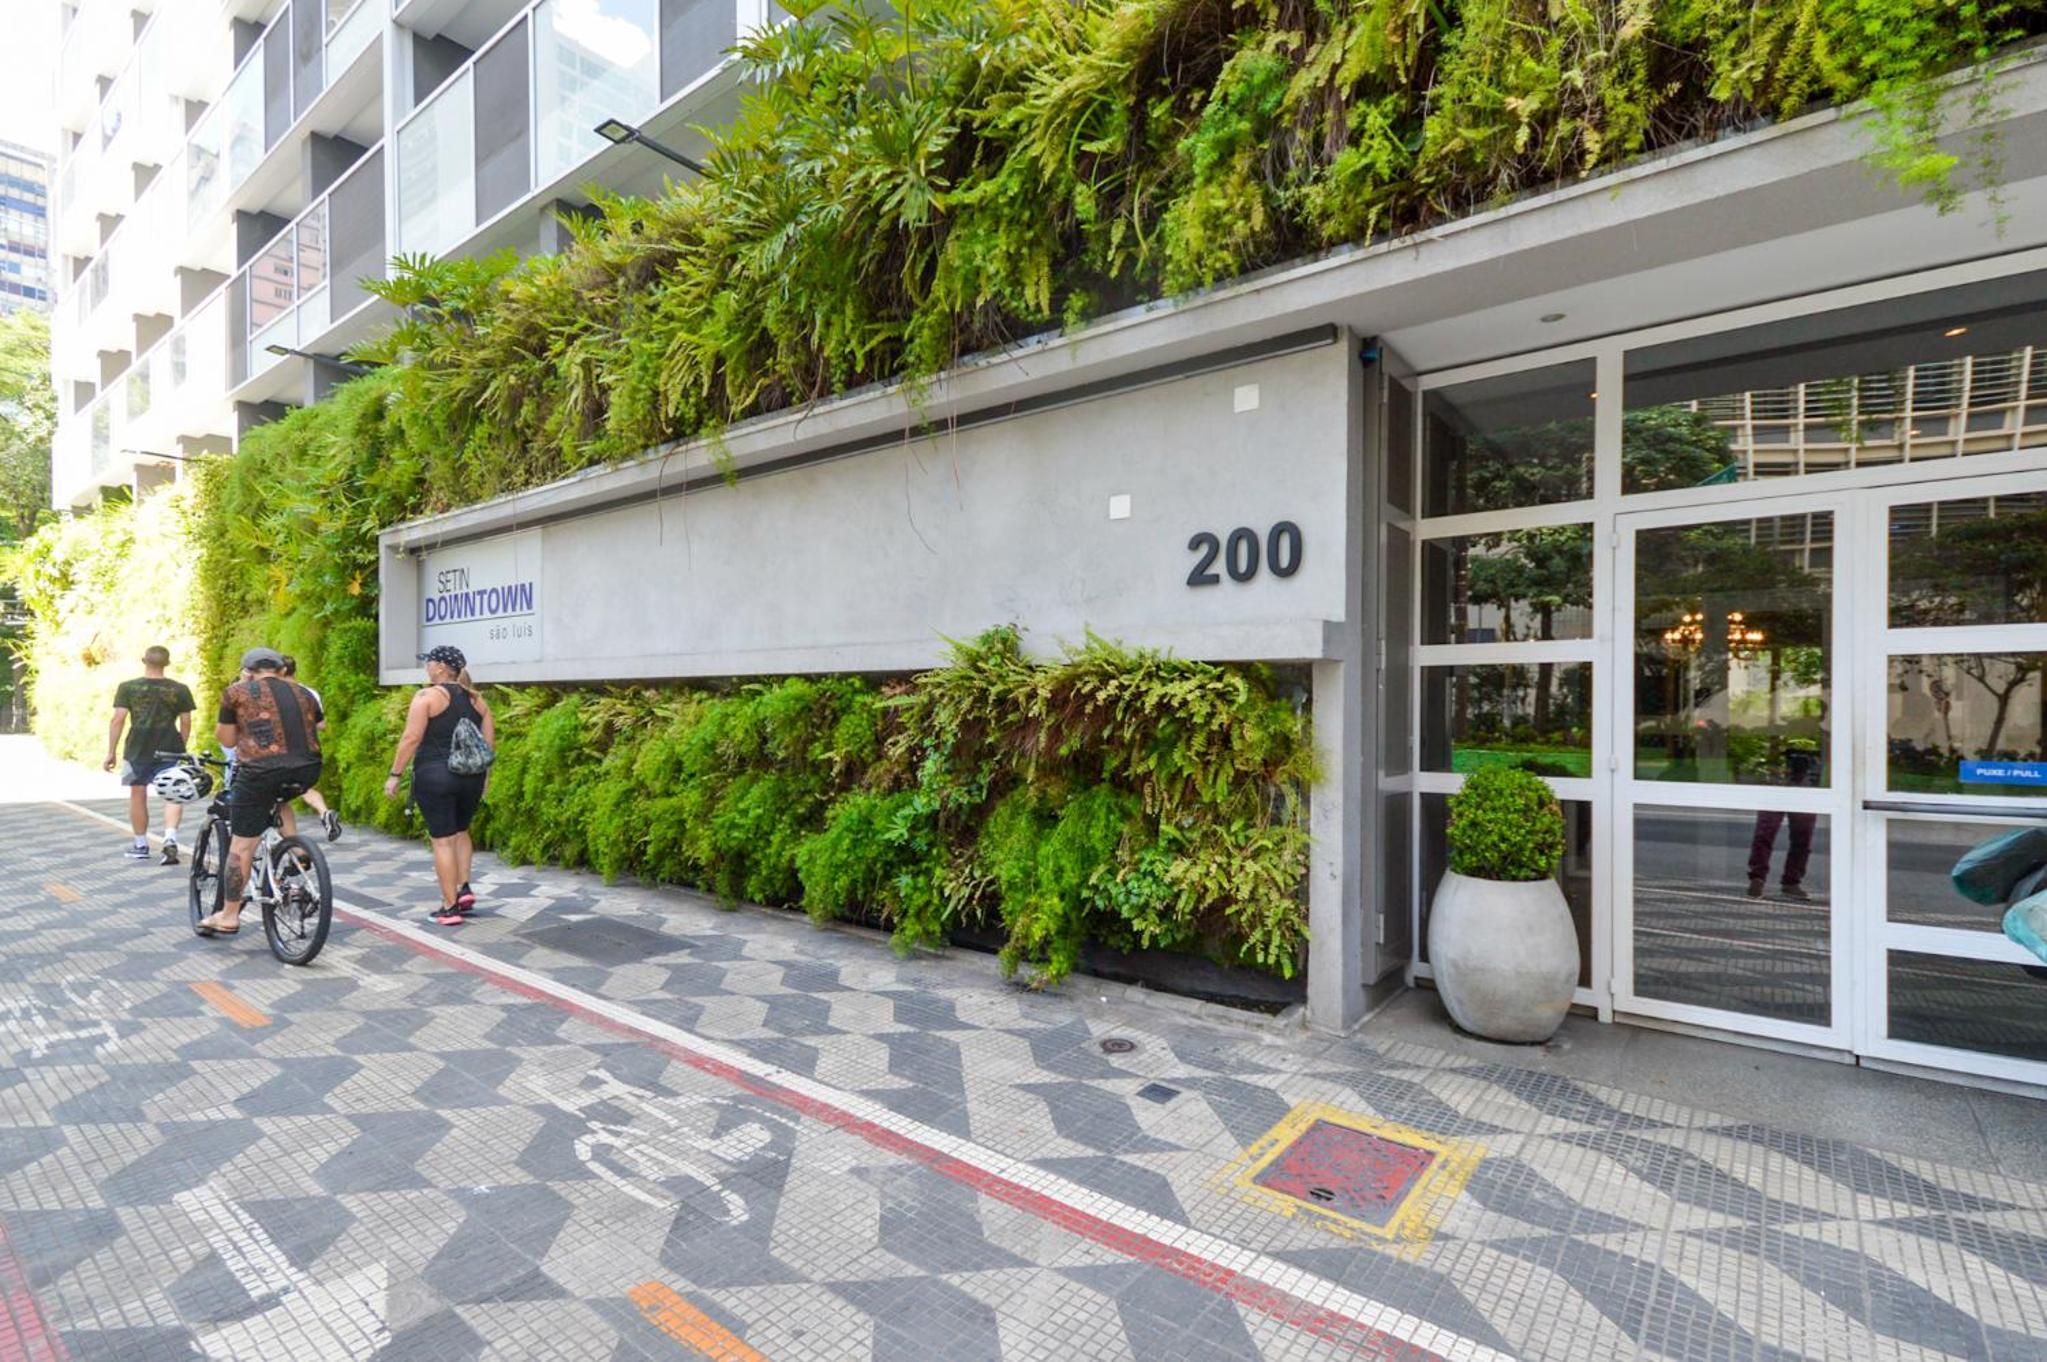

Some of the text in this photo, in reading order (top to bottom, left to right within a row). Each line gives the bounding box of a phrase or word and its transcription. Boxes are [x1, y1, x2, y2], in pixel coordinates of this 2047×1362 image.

[1187, 520, 1303, 586] 200
[437, 568, 470, 594] SETIN
[425, 582, 533, 623] DOWNTOWN
[2013, 769, 2042, 778] PULL
